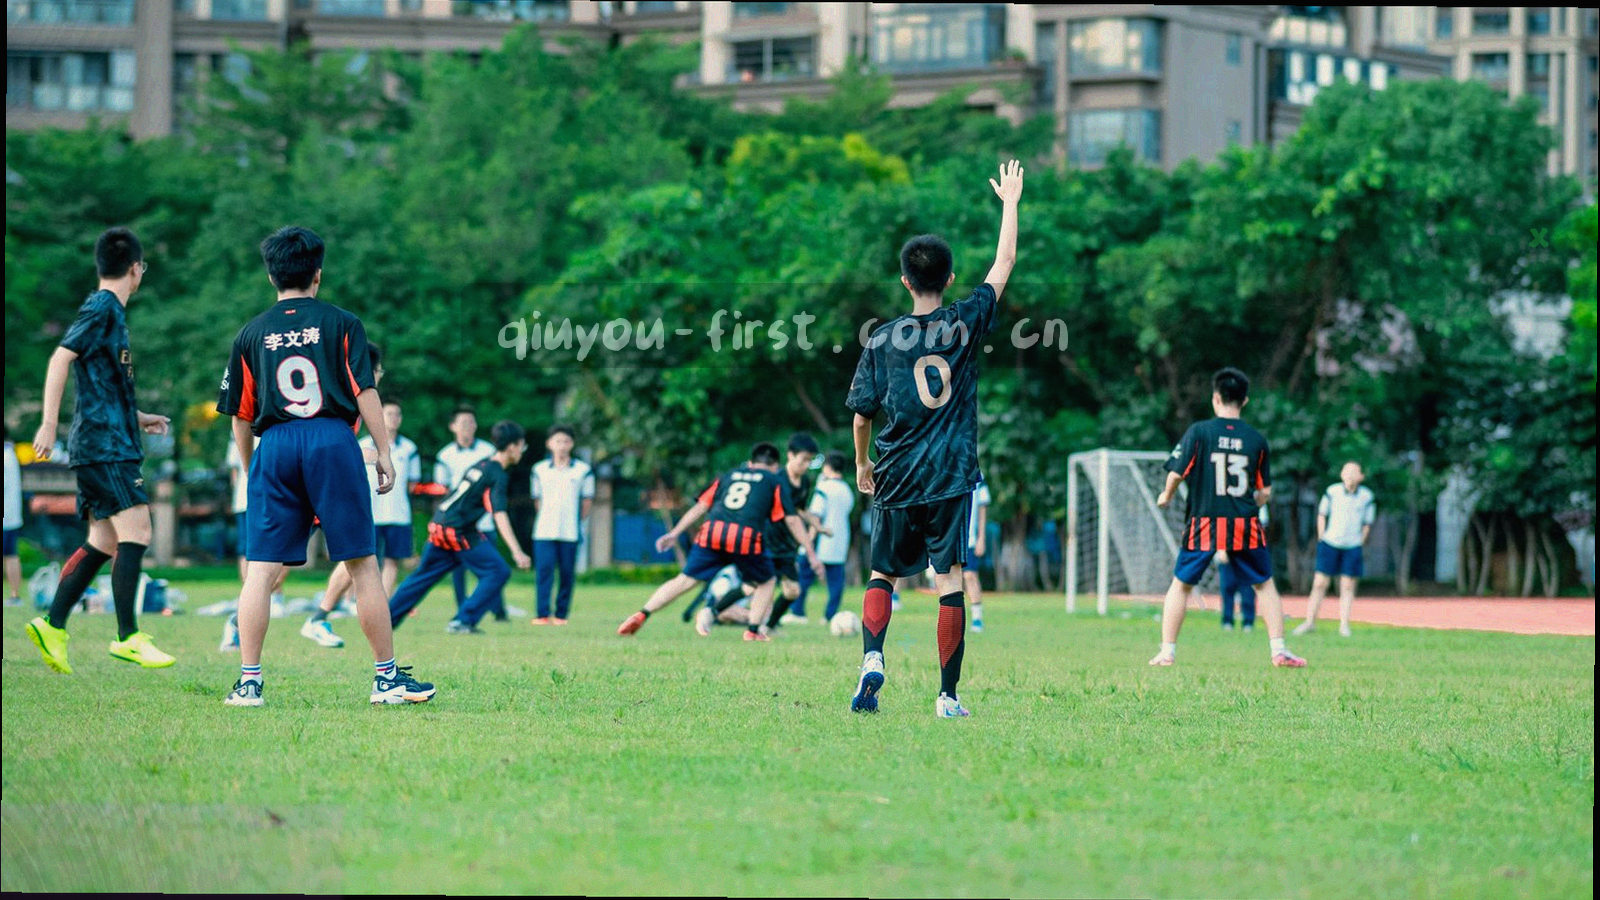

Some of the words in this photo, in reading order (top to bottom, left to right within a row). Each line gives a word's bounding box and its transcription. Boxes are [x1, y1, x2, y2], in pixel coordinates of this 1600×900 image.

[263, 326, 321, 352] 李文涛
[276, 355, 324, 419] 9
[1210, 453, 1249, 497] 13
[724, 481, 752, 510] 8
